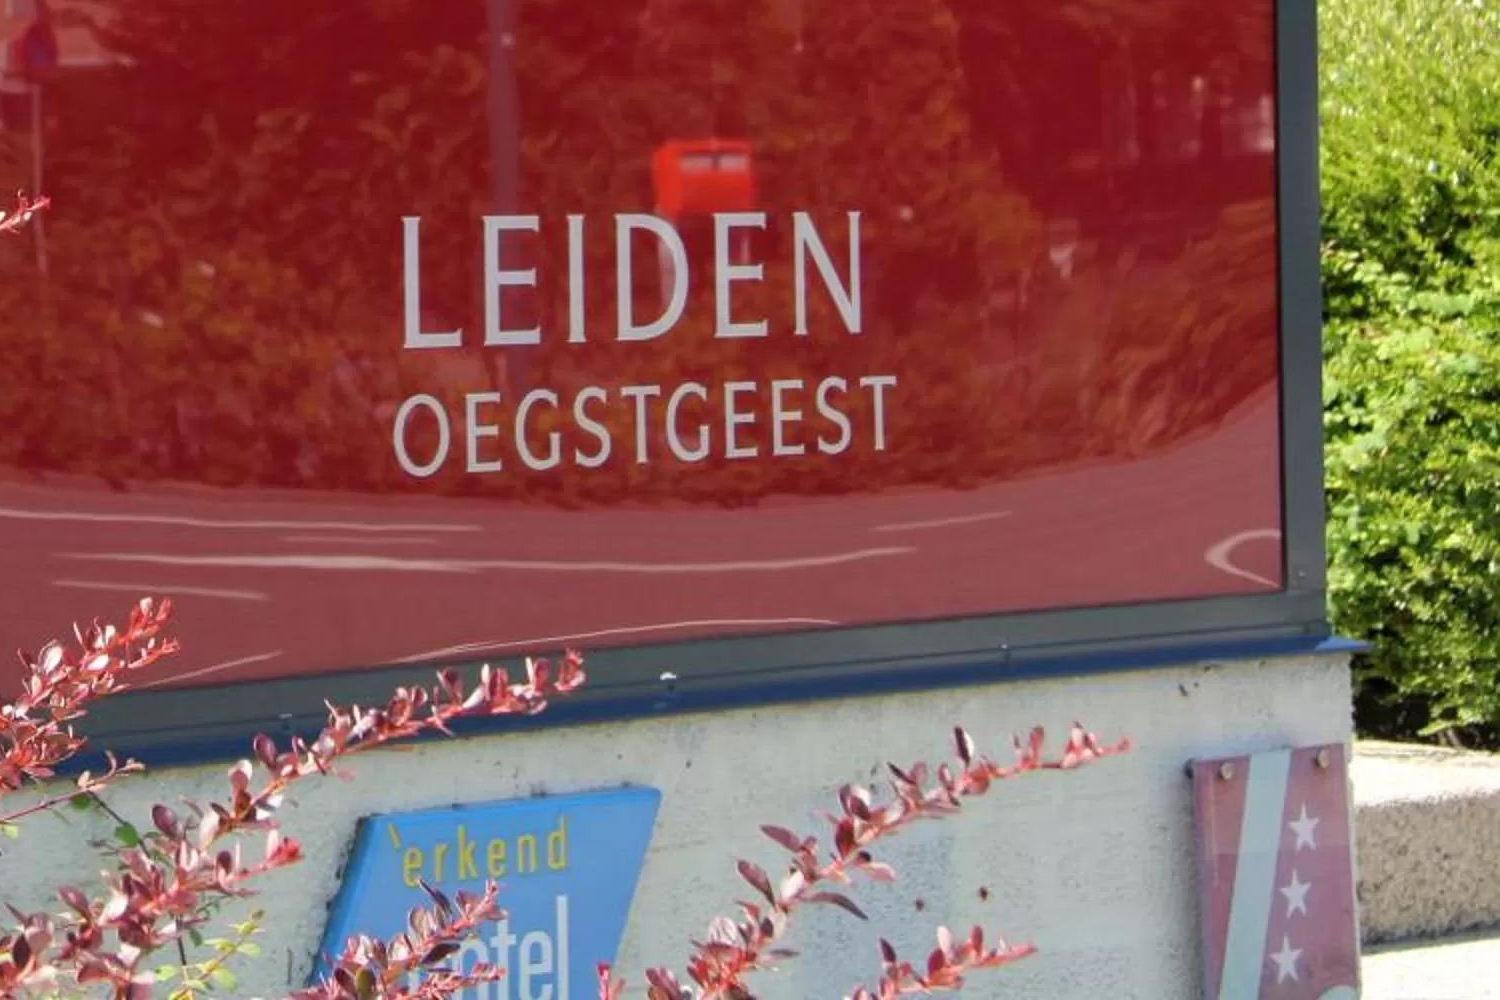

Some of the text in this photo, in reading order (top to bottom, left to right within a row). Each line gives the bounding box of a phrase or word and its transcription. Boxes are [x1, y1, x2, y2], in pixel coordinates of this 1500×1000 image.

[401, 210, 863, 350] LEIDEN
[392, 374, 898, 478] OEGSTGEEST
[405, 894, 569, 1000] otel
